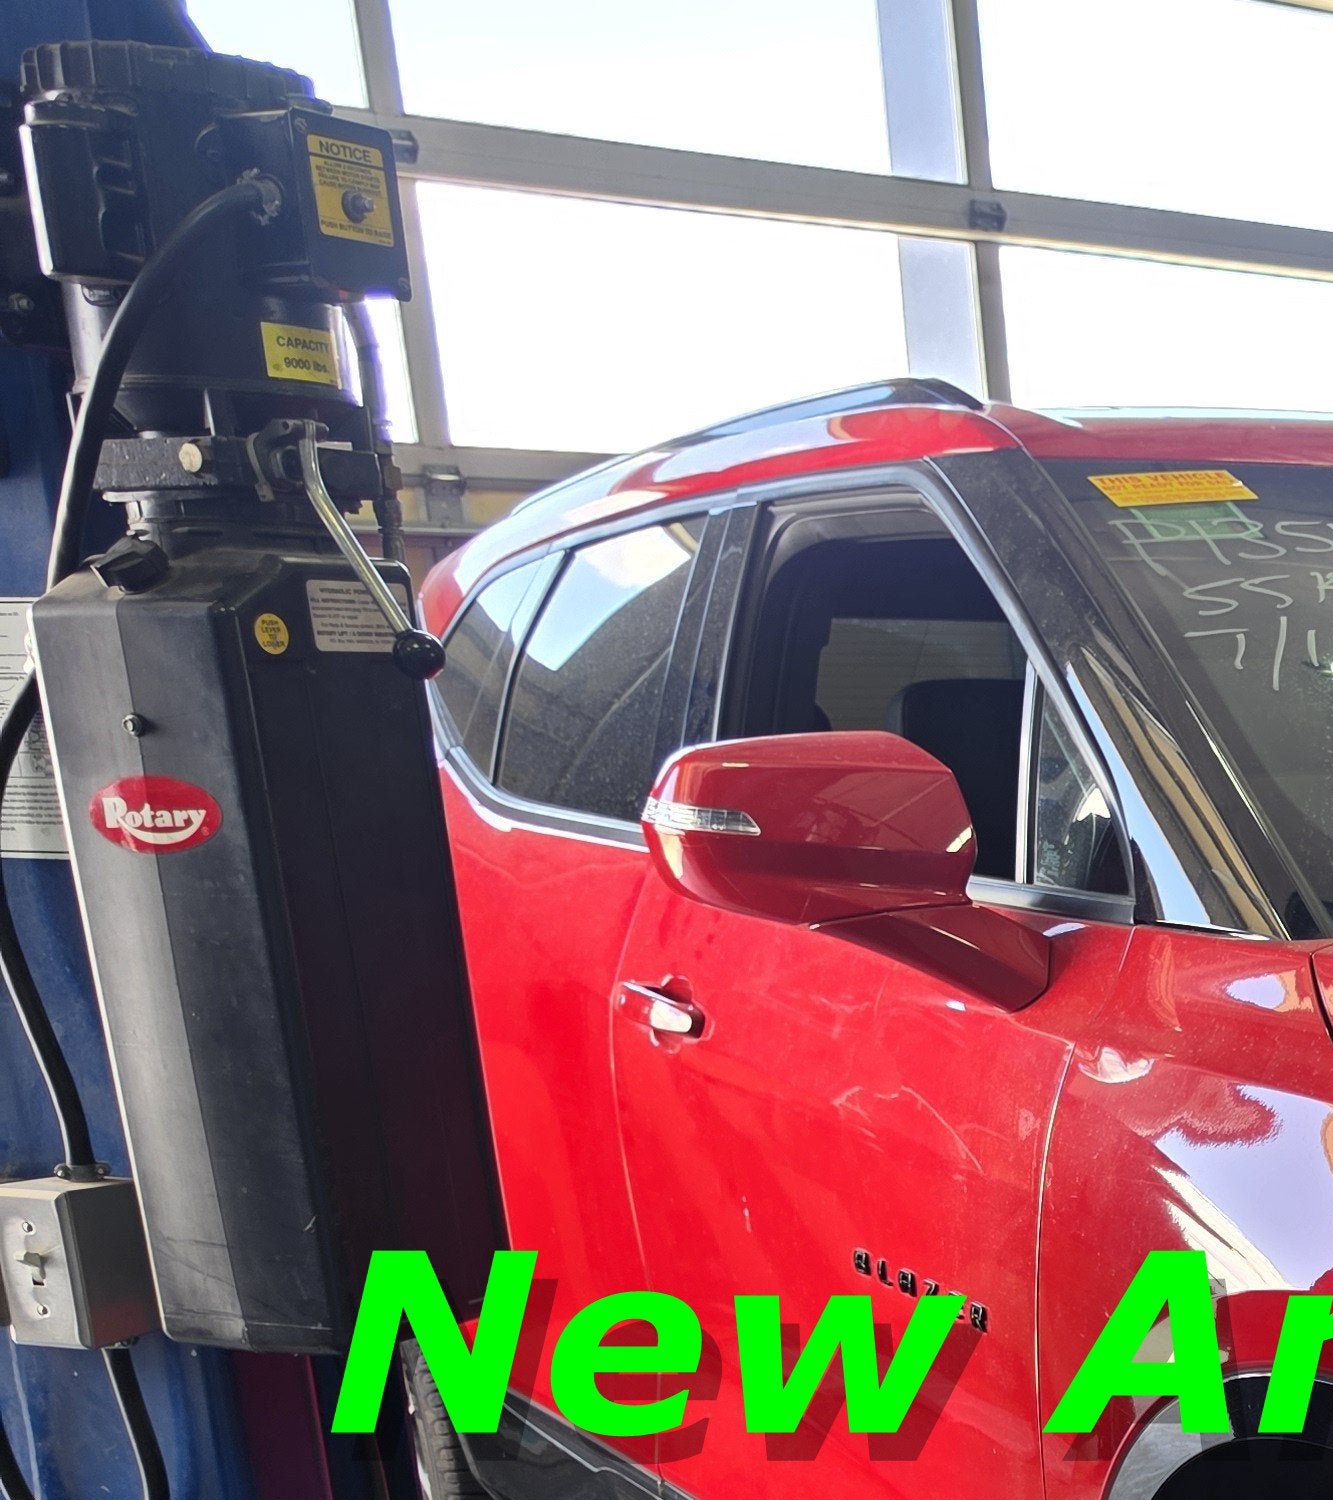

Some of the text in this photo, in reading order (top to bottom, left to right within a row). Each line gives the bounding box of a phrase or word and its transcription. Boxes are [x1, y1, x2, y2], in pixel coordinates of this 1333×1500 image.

[318, 140, 372, 163] NOTICE
[275, 335, 329, 354] CAPACITY
[283, 357, 311, 371] 9000
[101, 797, 207, 845] Rotary
